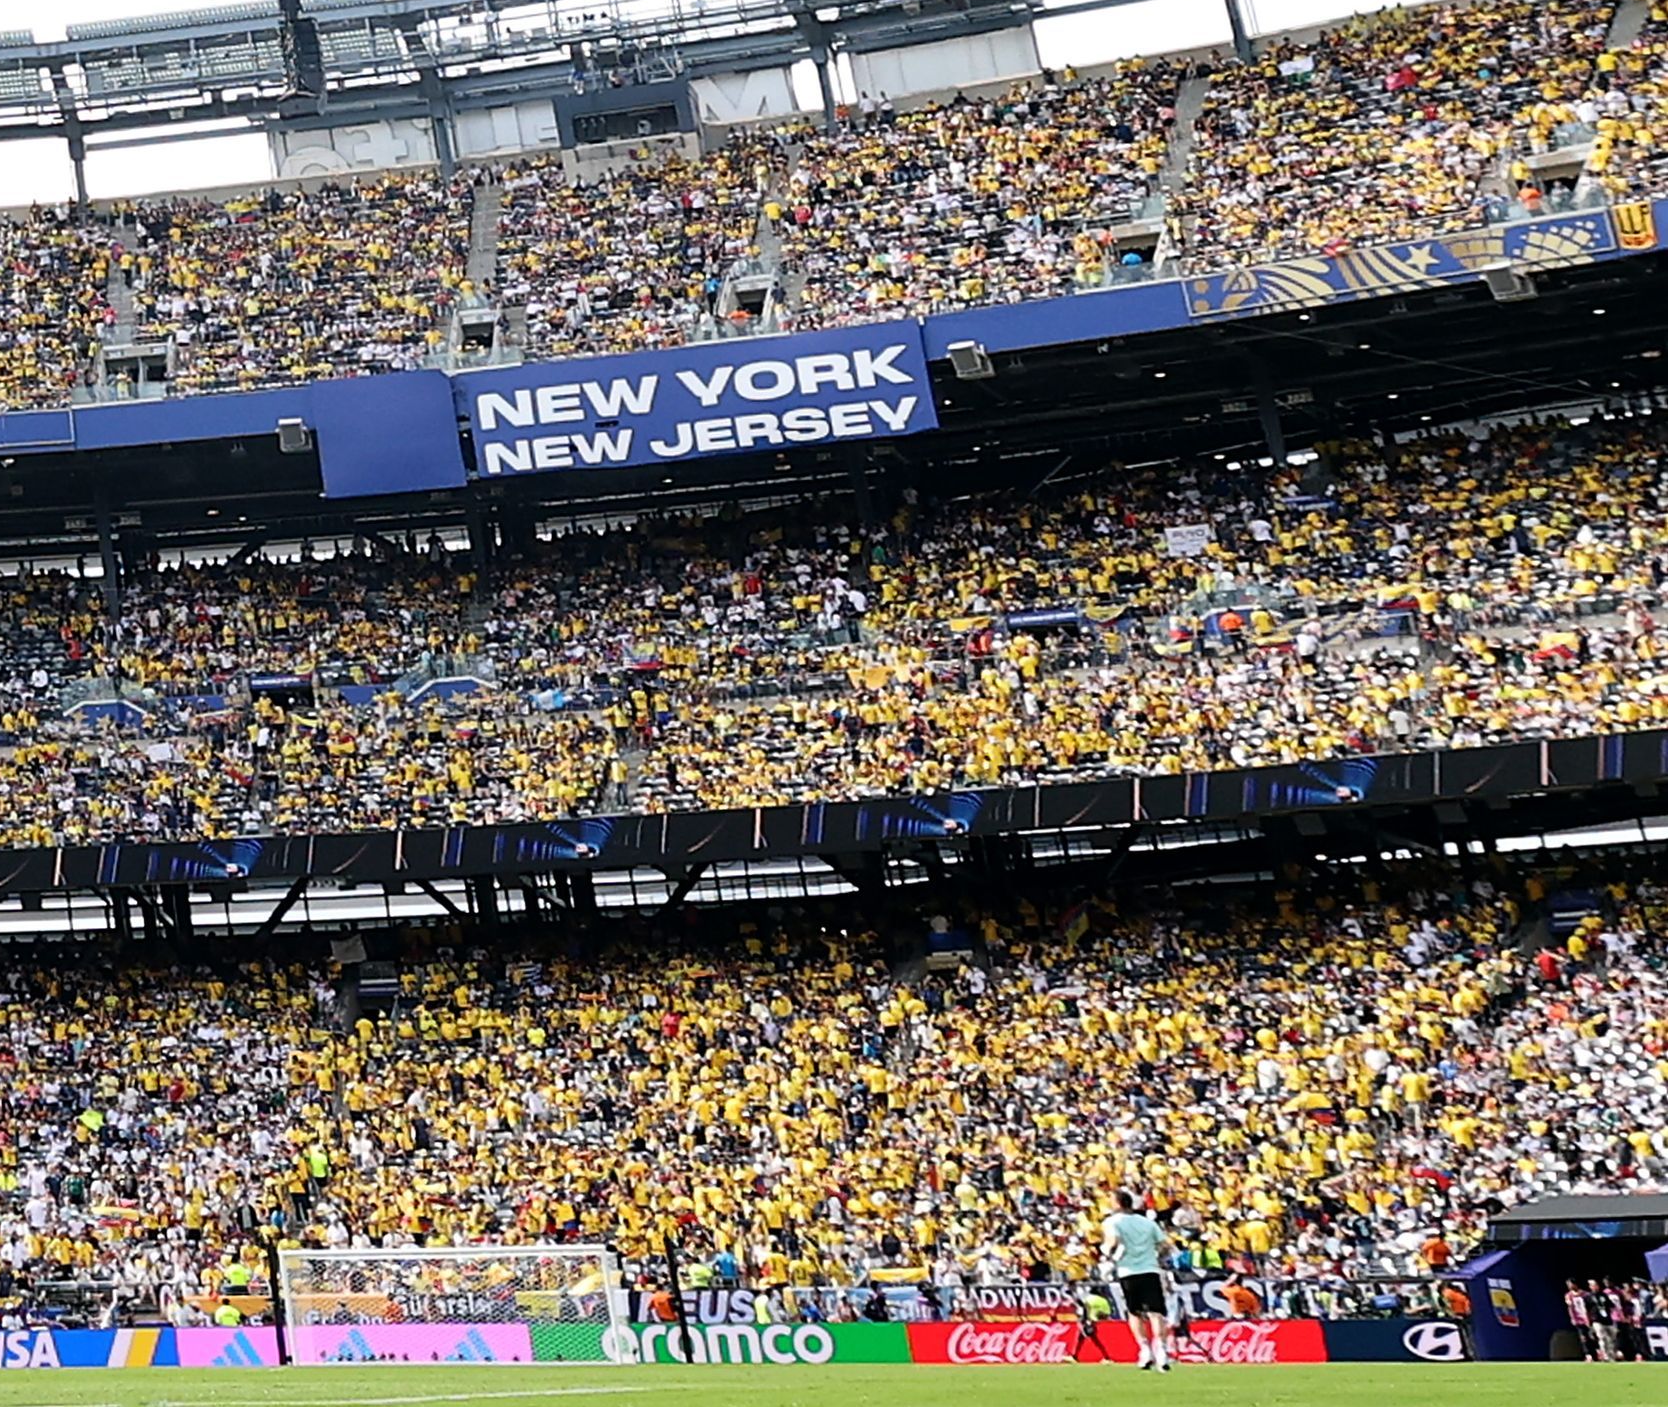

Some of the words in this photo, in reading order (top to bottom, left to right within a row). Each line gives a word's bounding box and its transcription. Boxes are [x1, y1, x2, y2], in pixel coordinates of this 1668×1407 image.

[476, 375, 659, 431] NEW
[676, 344, 914, 407] YORK
[484, 428, 633, 475] NEW
[651, 395, 919, 458] JERSEY
[638, 1290, 756, 1324] EUS
[601, 1324, 834, 1364] aramco
